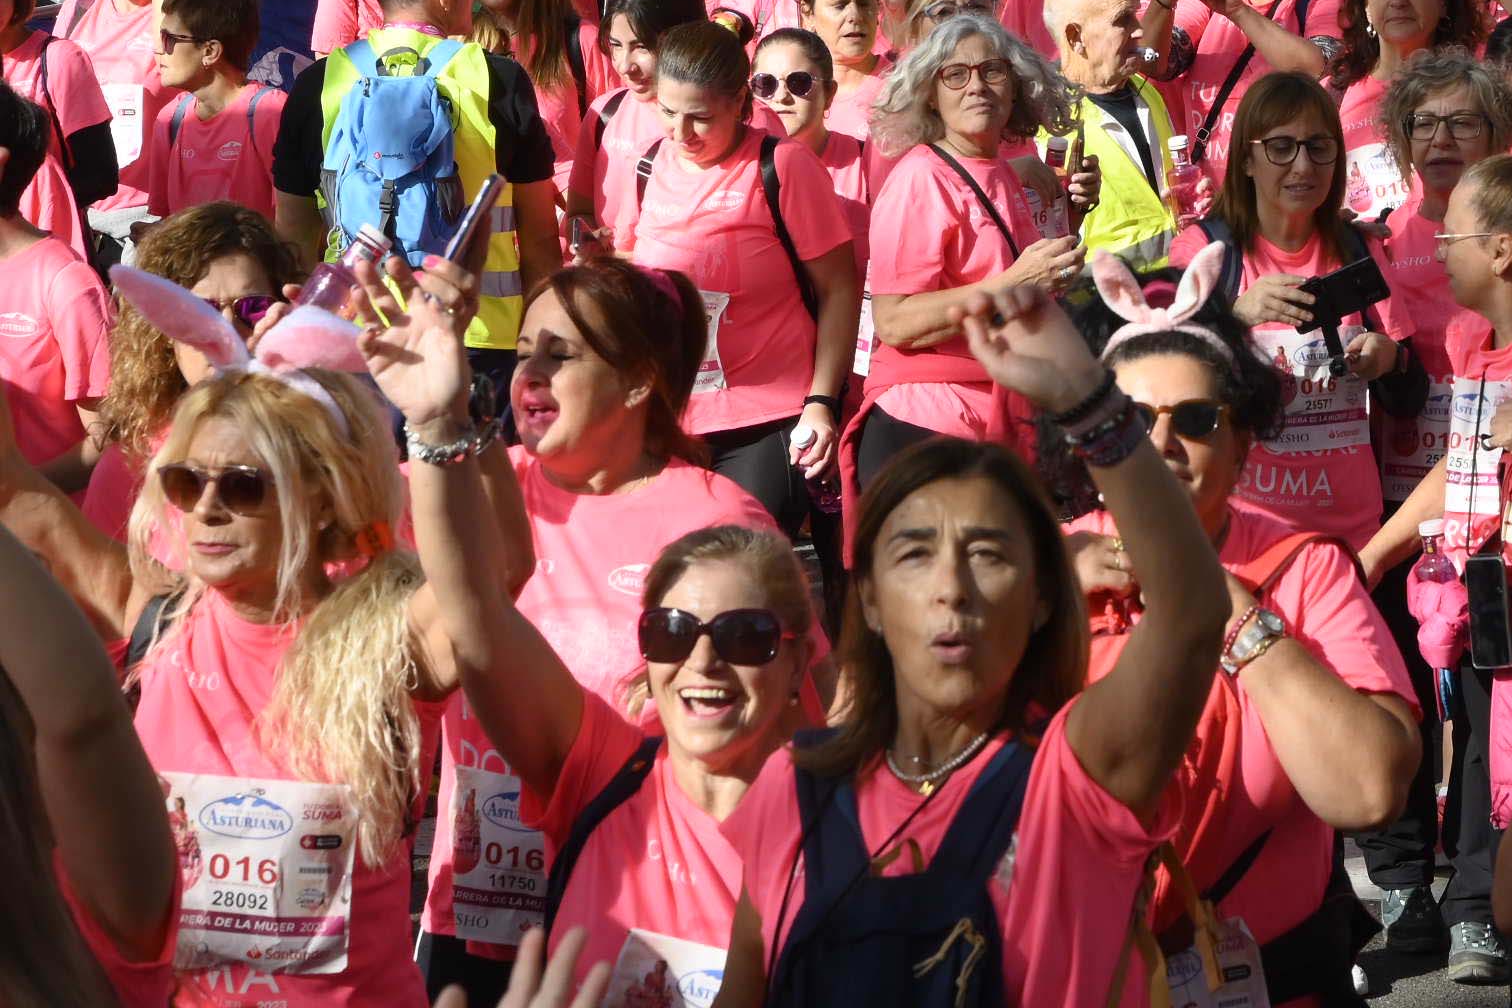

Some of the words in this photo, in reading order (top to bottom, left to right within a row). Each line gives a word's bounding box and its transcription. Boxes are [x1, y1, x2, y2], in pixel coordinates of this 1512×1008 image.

[1301, 376, 1338, 394] 016
[206, 810, 286, 832] ASTURIANA
[302, 809, 343, 821] SUMA
[484, 842, 544, 872] 016
[209, 853, 279, 884] 016
[488, 873, 537, 892] 11750
[211, 890, 268, 910] 28092
[509, 897, 522, 907] LA
[214, 916, 231, 927] DE
[235, 919, 252, 929] LA
[254, 920, 295, 933] MUJER
